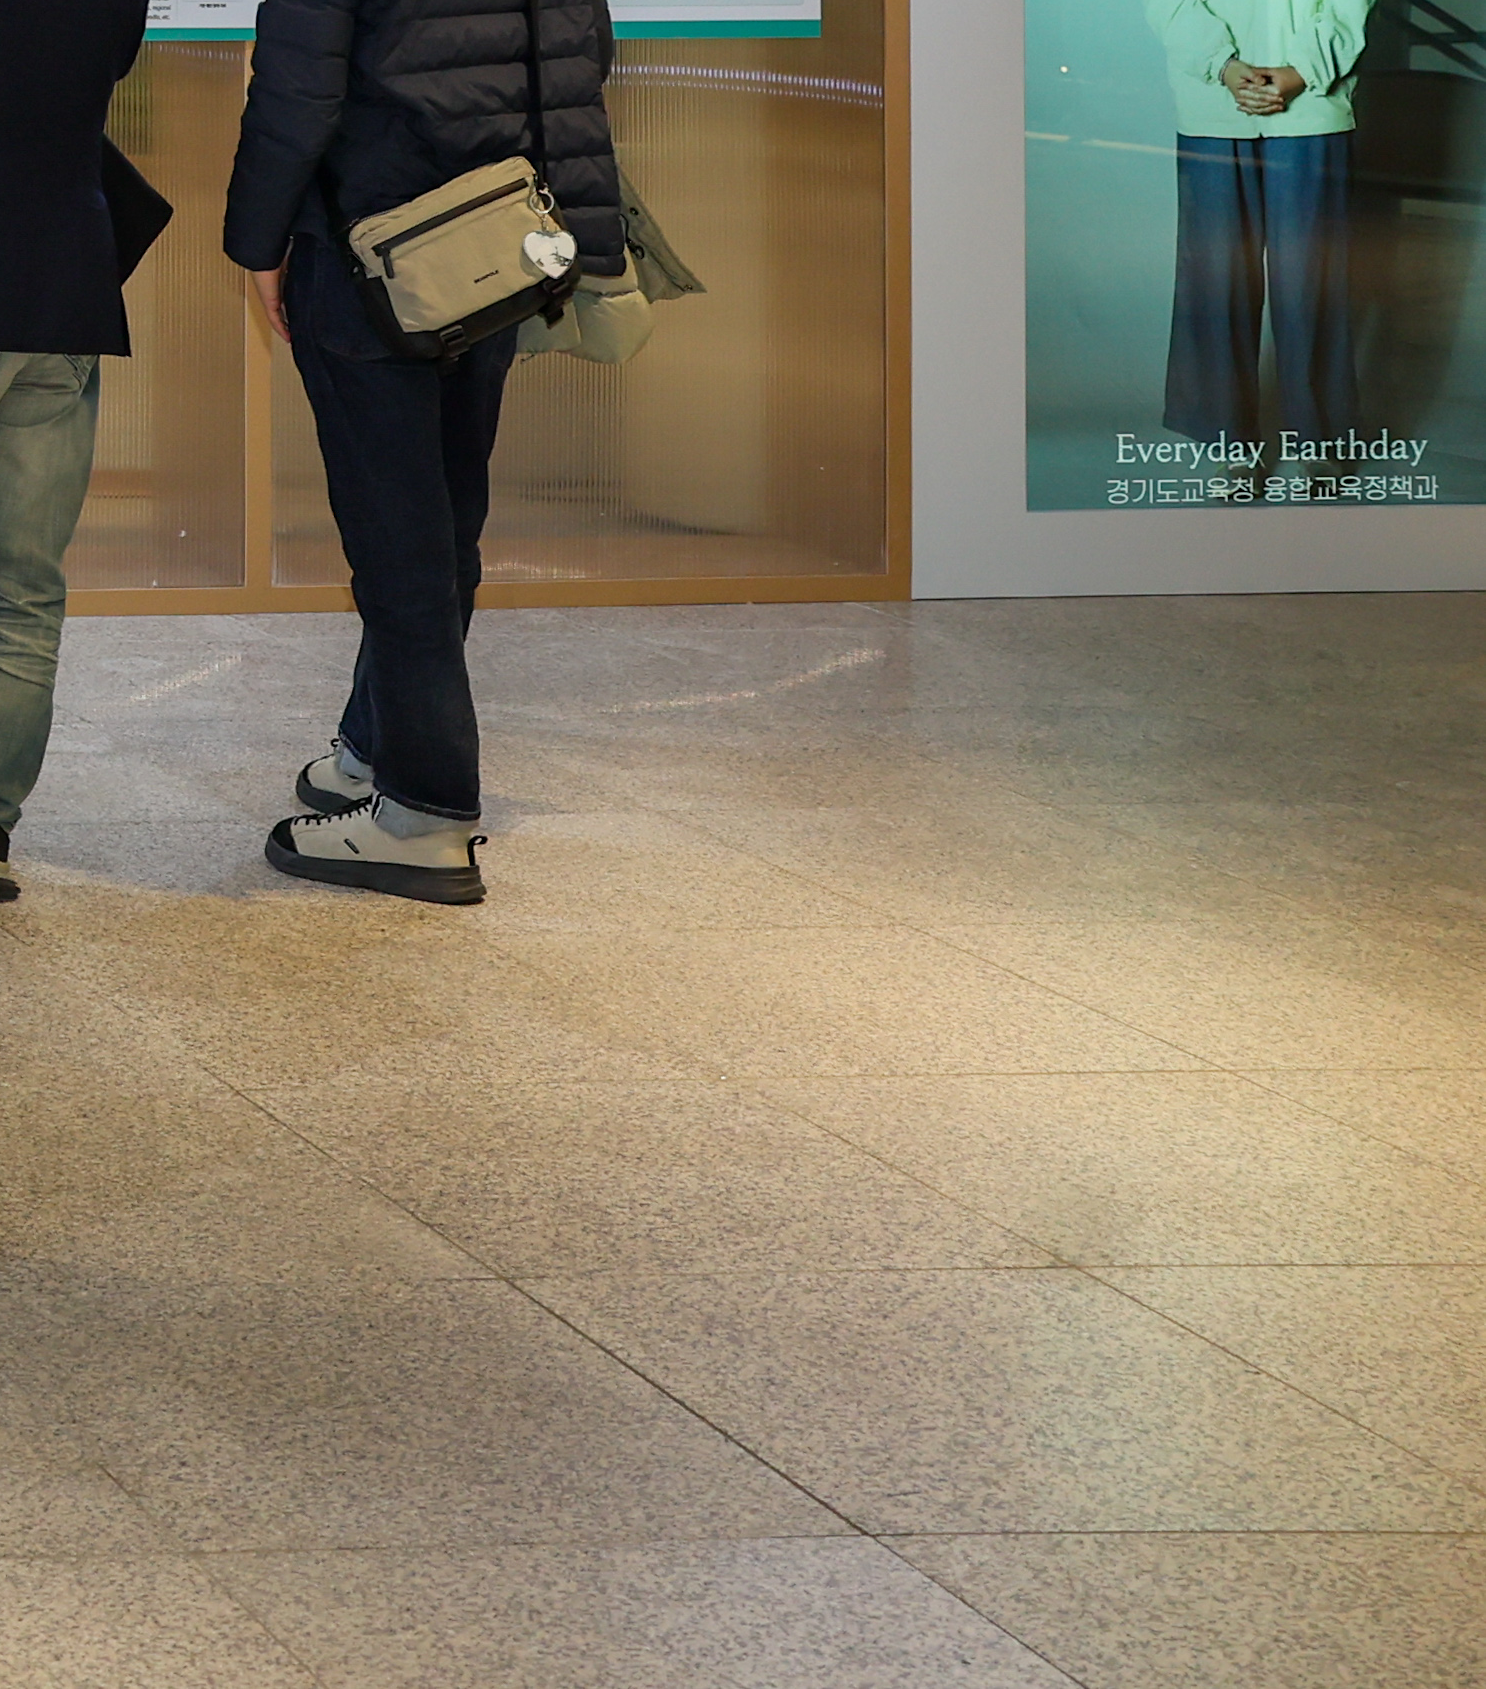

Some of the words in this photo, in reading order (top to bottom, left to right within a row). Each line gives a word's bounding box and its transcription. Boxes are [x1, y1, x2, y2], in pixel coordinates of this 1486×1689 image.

[1116, 430, 1265, 469] Everyday
[1279, 428, 1428, 467] Earthday
[1106, 476, 1255, 505] 경기도교육청
[1263, 474, 1440, 504] 융합교육정책과
